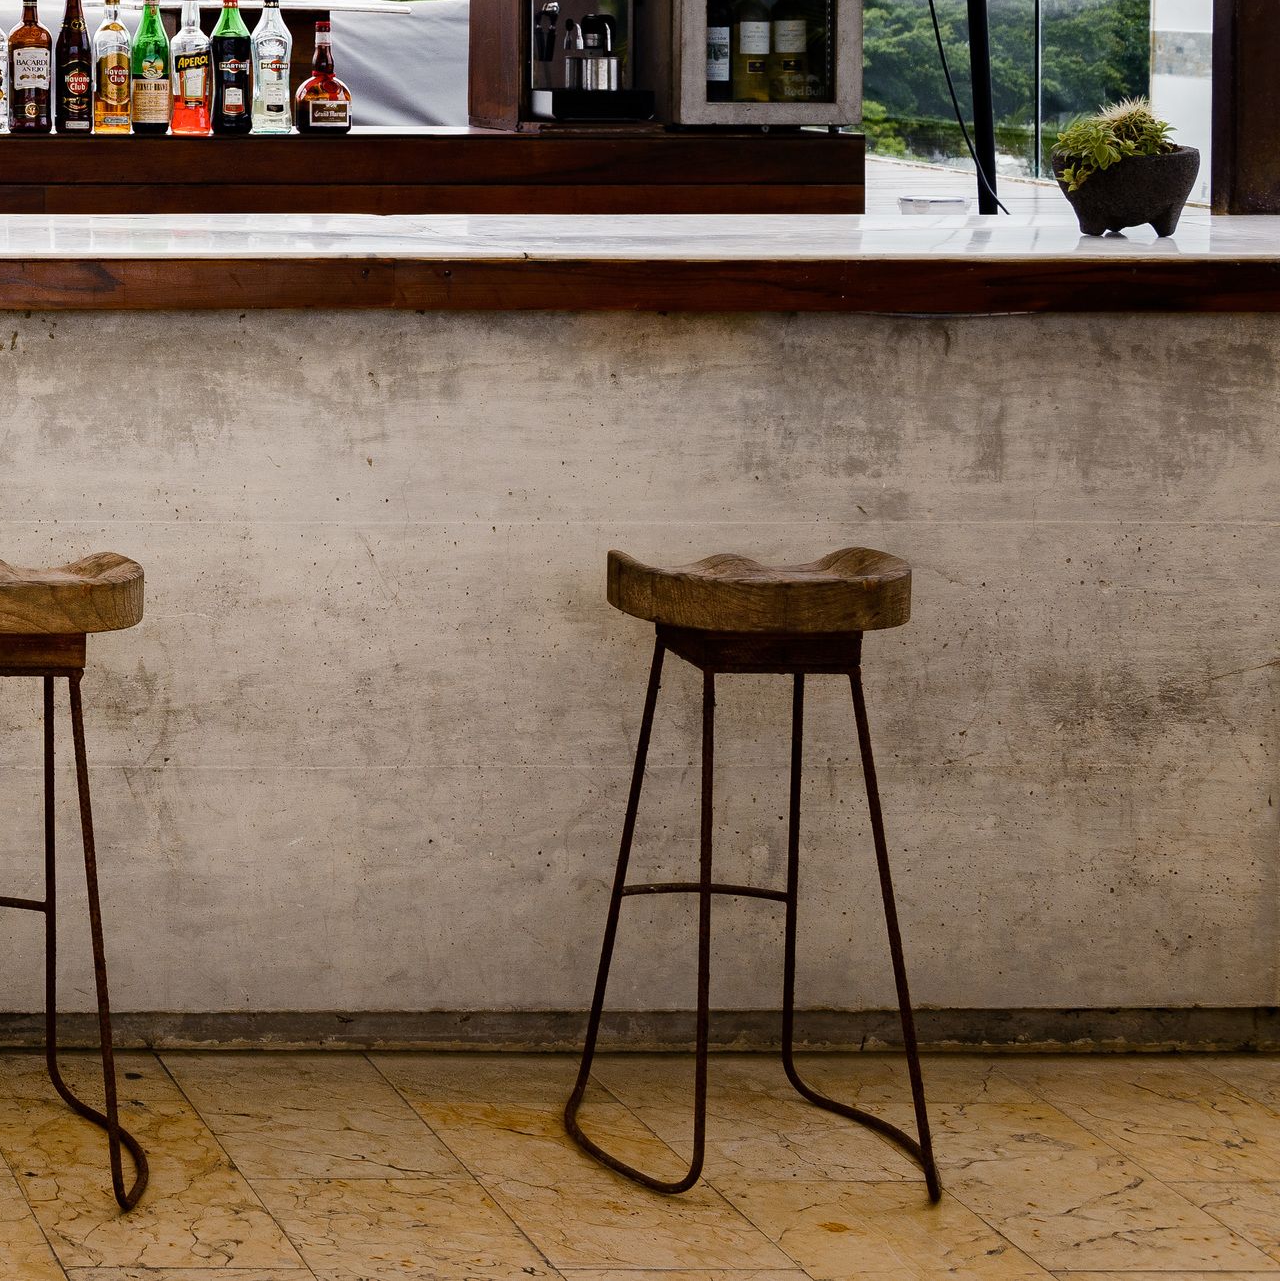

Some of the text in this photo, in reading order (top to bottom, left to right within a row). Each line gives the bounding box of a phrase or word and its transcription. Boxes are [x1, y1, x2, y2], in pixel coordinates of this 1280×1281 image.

[178, 55, 208, 69] APEROL
[104, 68, 129, 76] Havana
[65, 75, 90, 83] Havana
[109, 75, 125, 83] Club
[69, 83, 86, 91] Club
[784, 85, 825, 97] Red Bull
[314, 110, 347, 118] Grand Marnier
